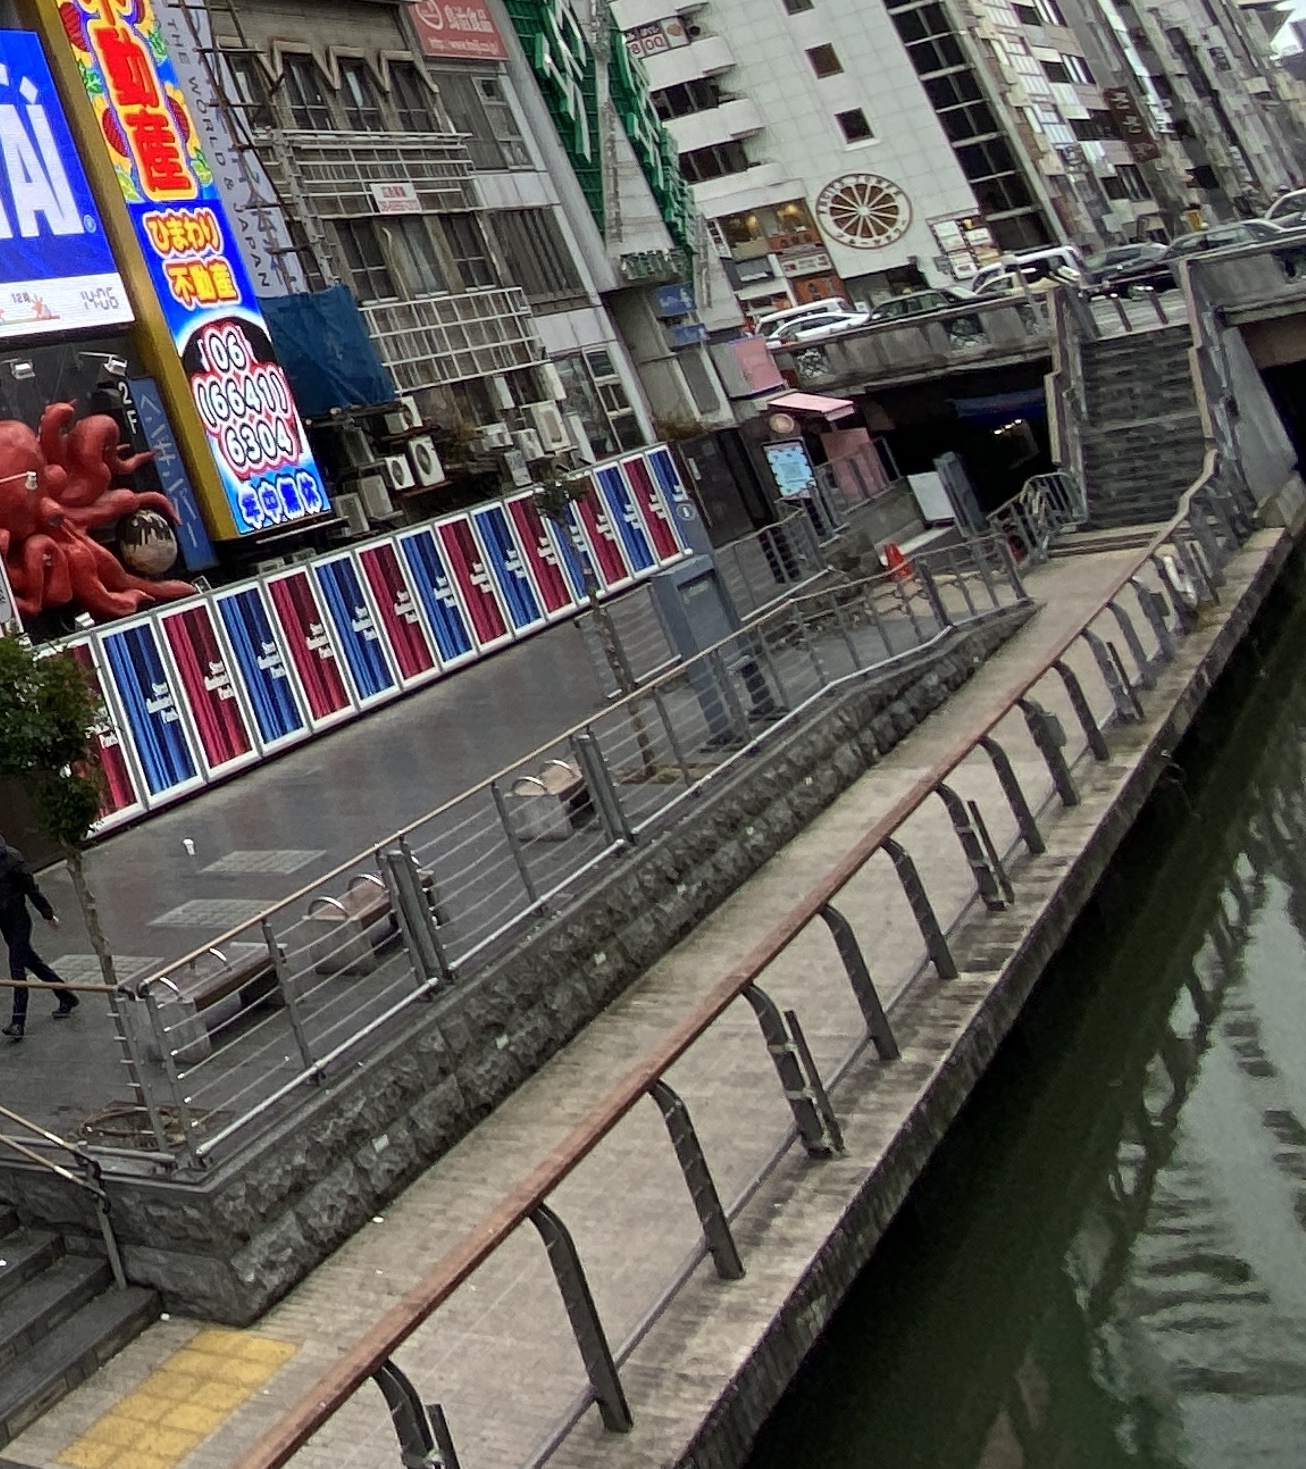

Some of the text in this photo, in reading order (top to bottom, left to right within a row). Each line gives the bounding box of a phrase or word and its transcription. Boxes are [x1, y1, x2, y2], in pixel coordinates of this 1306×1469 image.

[145, 214, 224, 254] ひまわり
[169, 257, 237, 308] 不動産
[224, 418, 294, 468] 6304
[240, 469, 322, 530] 年中無休
